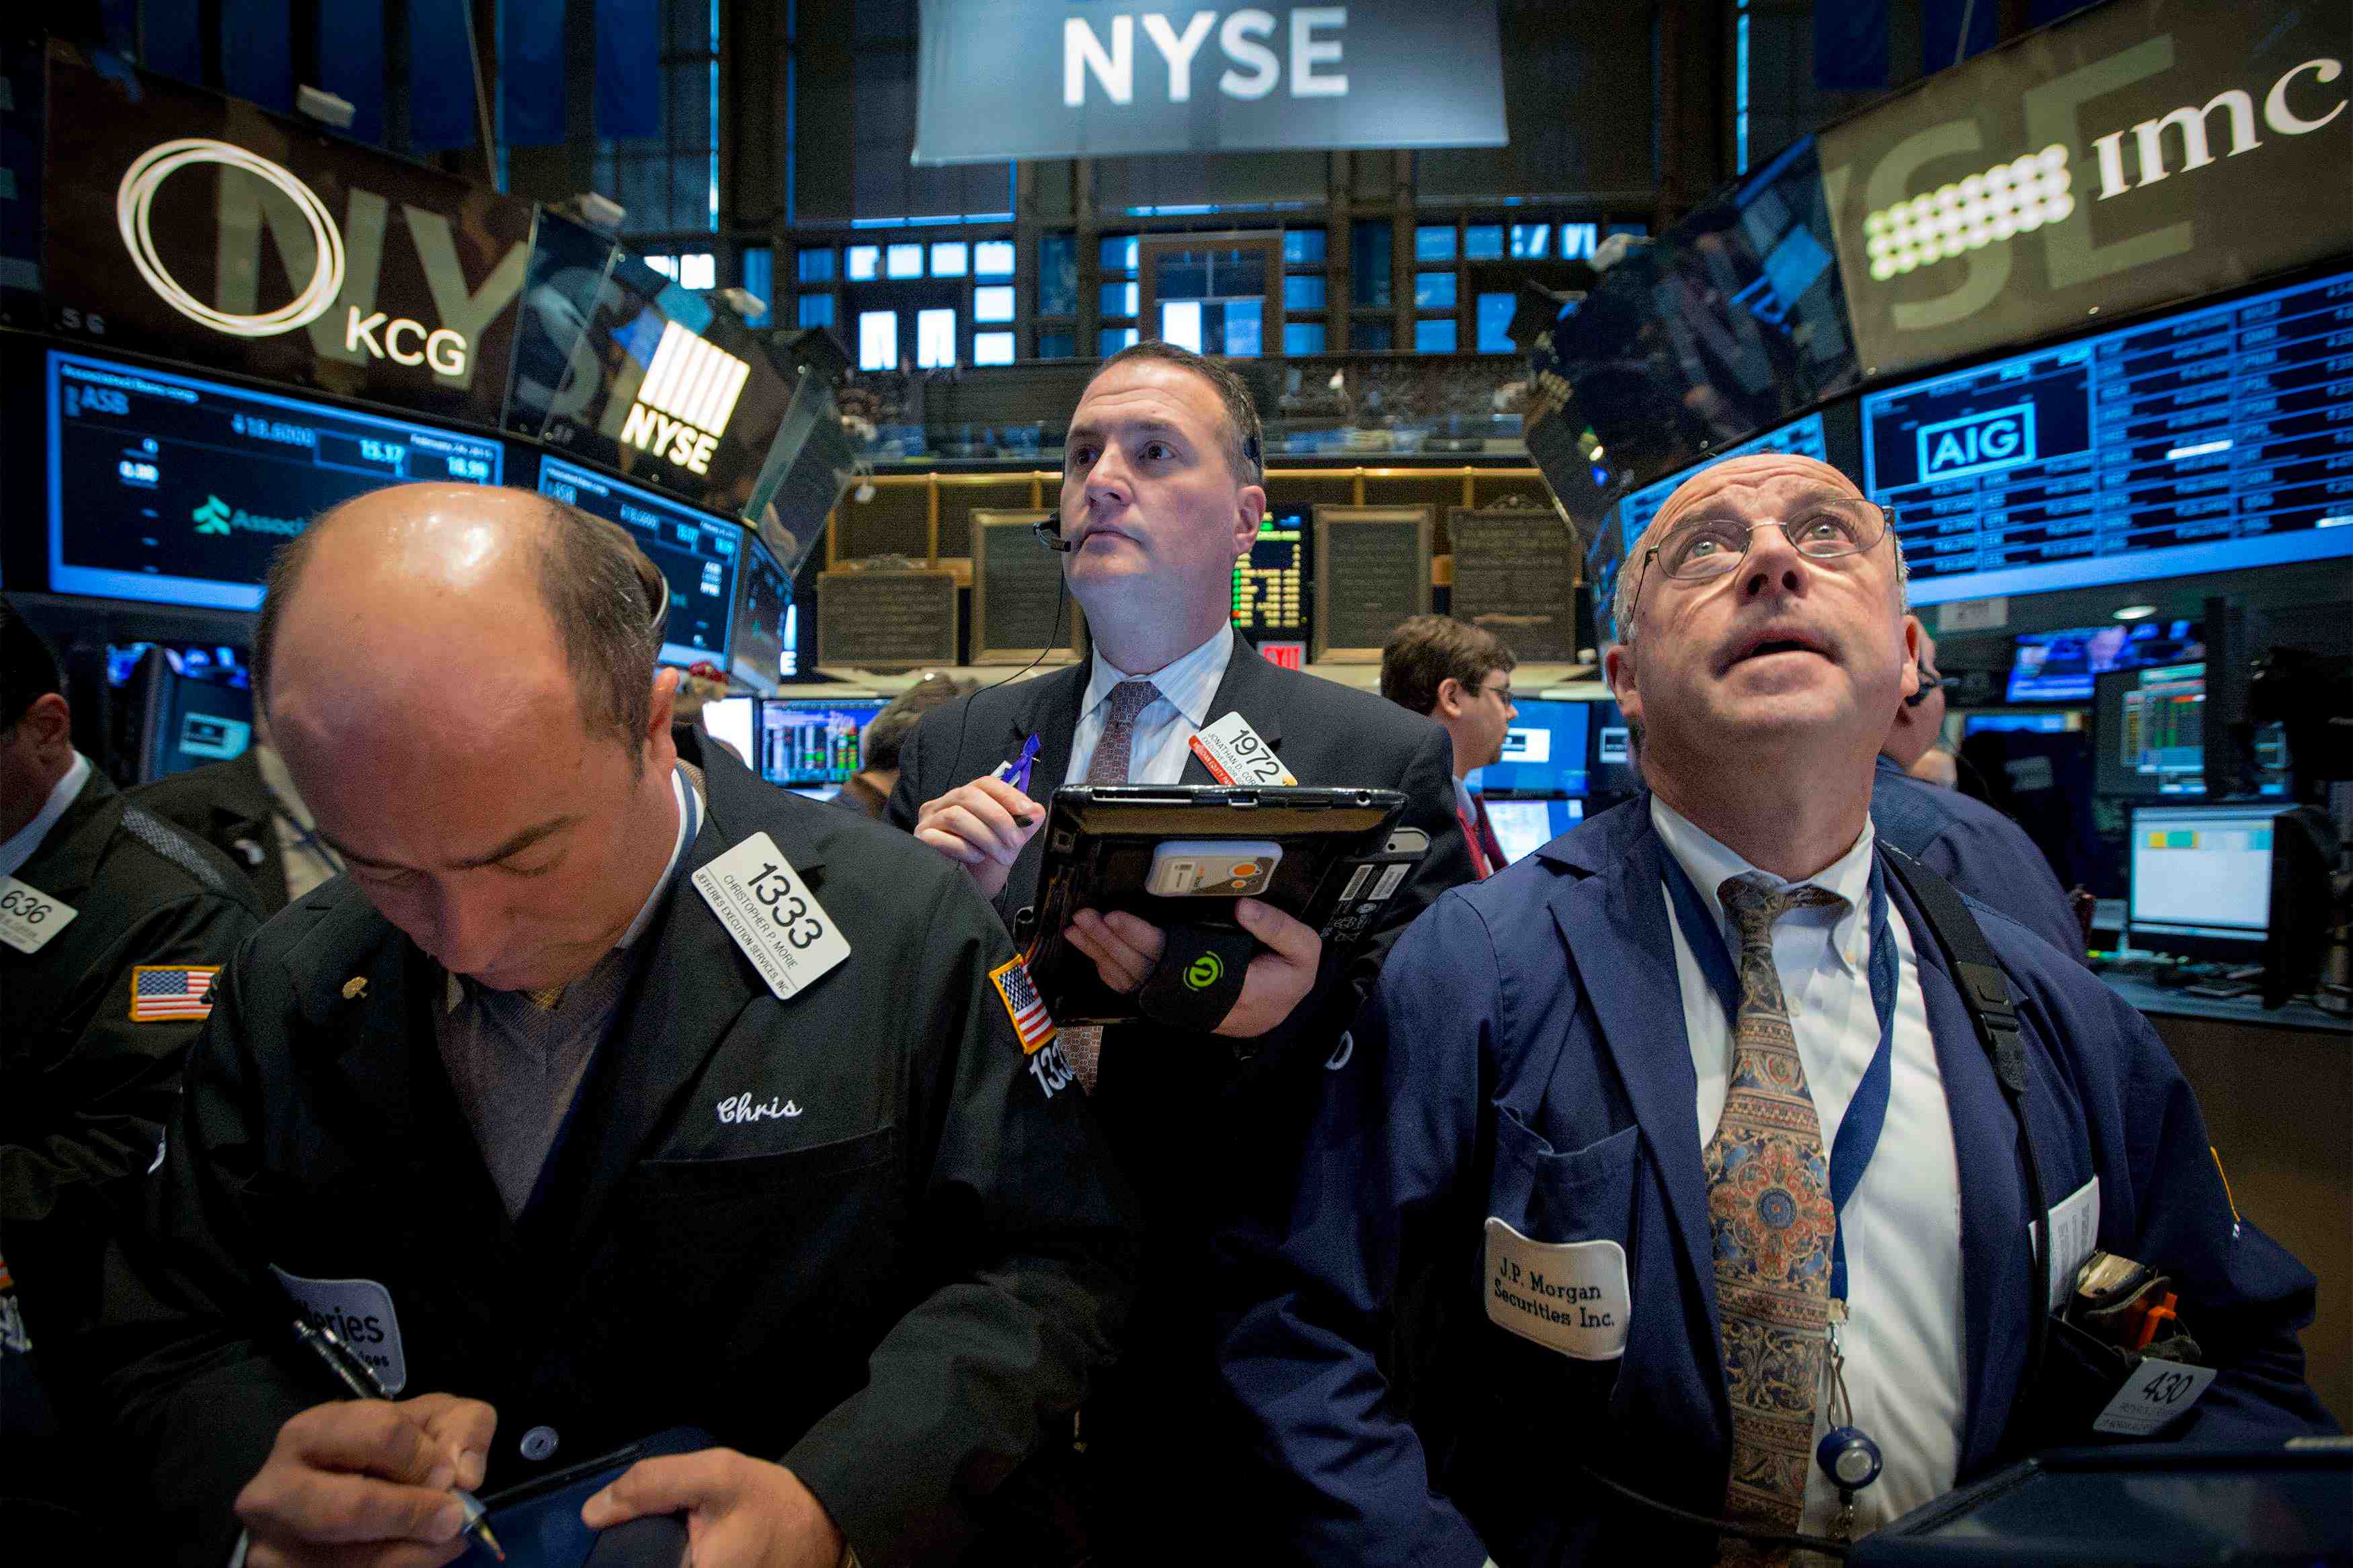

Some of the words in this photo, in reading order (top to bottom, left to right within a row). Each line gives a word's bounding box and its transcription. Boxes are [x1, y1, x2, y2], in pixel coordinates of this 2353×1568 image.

[1063, 7, 1349, 107] NYSE
[346, 305, 467, 376] KCG
[620, 401, 719, 475] NYSE
[1929, 419, 2020, 470] AIG
[1228, 728, 1281, 783] 1972
[1, 890, 52, 924] 636
[696, 872, 725, 908] JEFFERIES
[720, 905, 754, 946] EXECUTION
[723, 873, 770, 934] CHRISTOPHER
[766, 932, 777, 943] P.
[772, 940, 798, 969] MORIE
[747, 862, 823, 950] 1333
[717, 1091, 803, 1123] Chris
[1494, 1277, 1572, 1327] Securities
[1579, 1306, 1615, 1328] Inc.
[1500, 1257, 1525, 1286] J.P.
[1529, 1270, 1601, 1304] Morgan
[2142, 1370, 2194, 1405] 430
